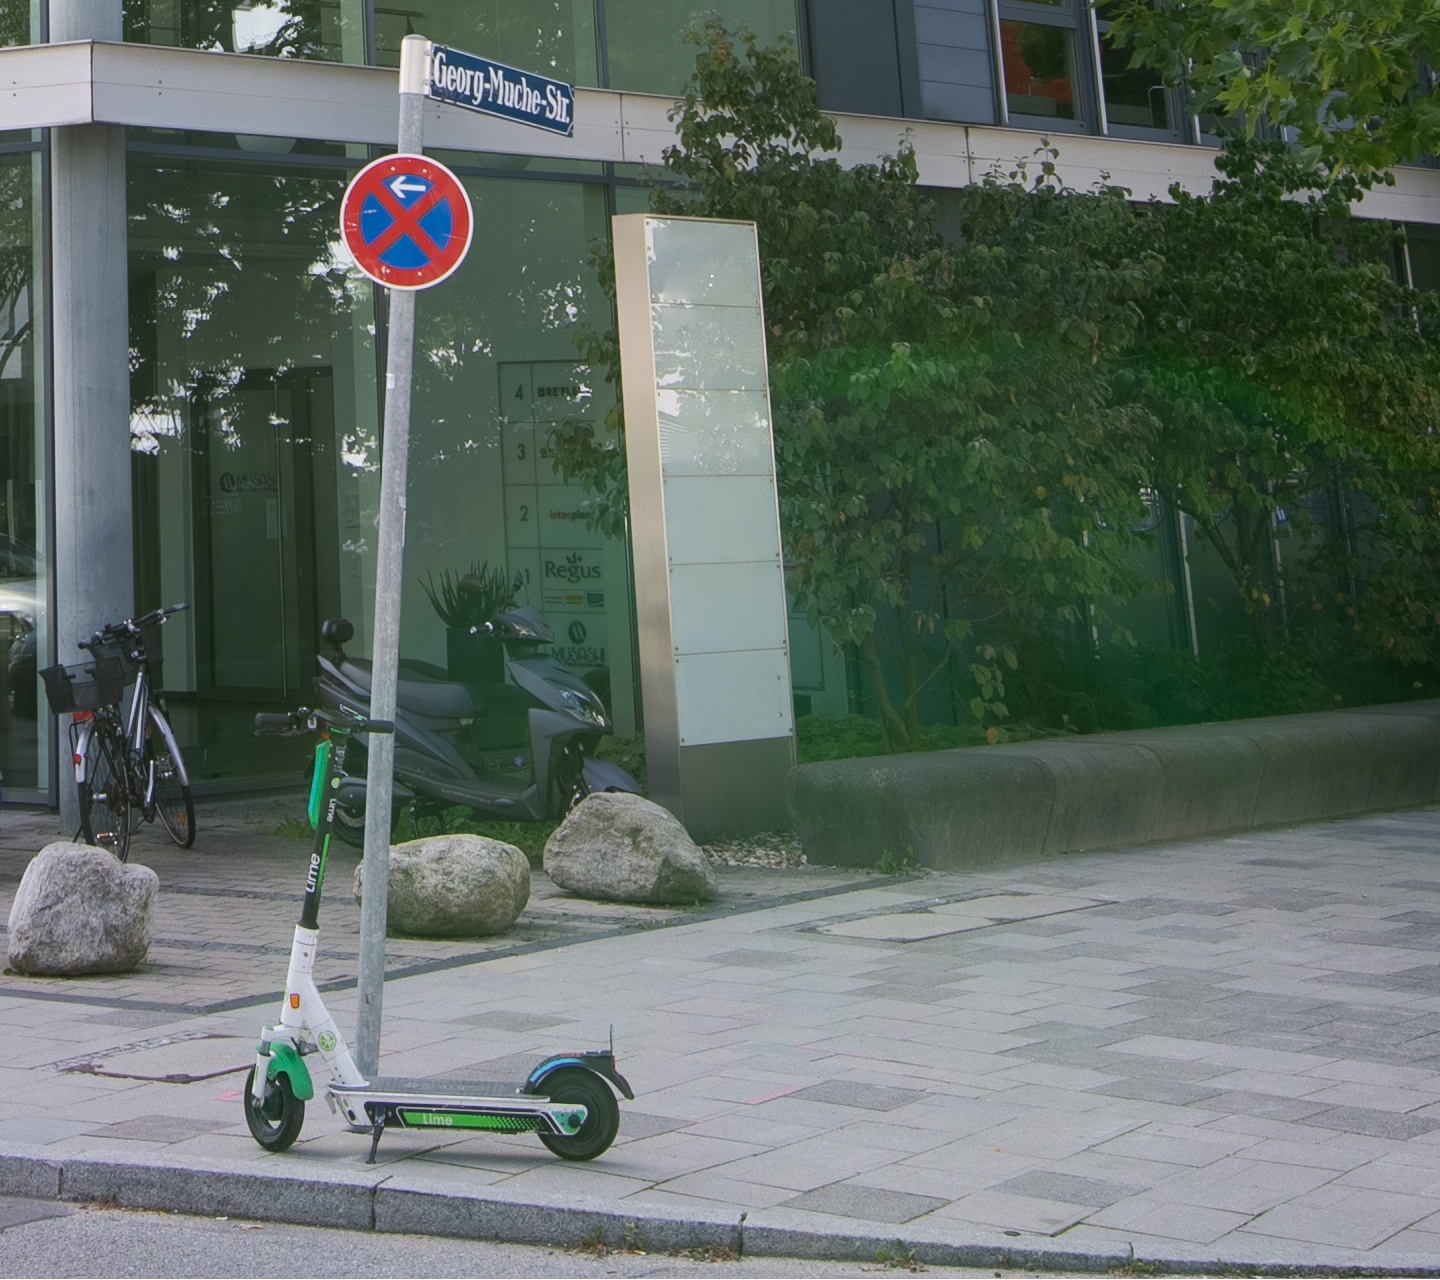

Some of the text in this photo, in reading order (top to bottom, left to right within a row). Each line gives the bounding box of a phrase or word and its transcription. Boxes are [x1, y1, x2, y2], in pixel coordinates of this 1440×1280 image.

[433, 52, 570, 124] Georg-Muche-Str.
[514, 383, 524, 400] 4
[517, 443, 526, 461] 3
[519, 505, 529, 522] 2
[545, 560, 602, 584] Regus
[306, 852, 321, 894] Lime
[422, 1112, 454, 1127] Lime
